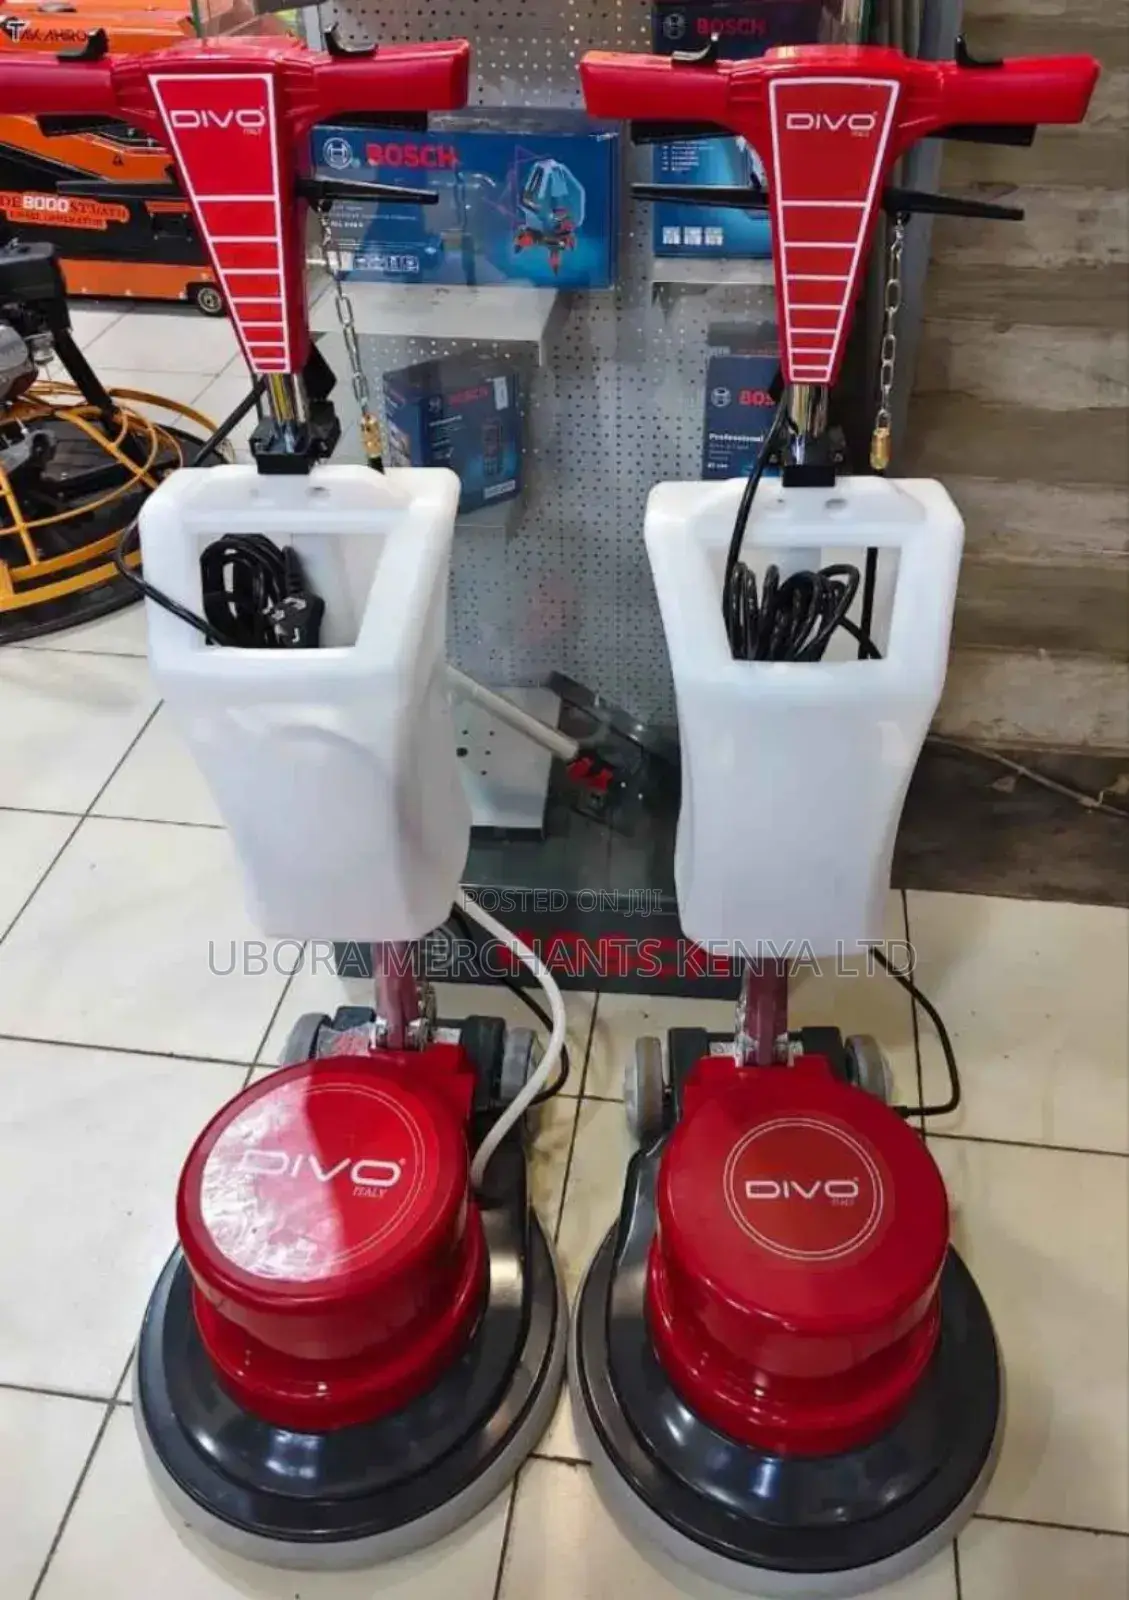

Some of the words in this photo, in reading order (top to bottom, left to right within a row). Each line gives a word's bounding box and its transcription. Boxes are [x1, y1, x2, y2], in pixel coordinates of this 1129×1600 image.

[170, 108, 266, 129] DIVO
[786, 113, 876, 131] DIVO
[366, 143, 458, 168] BOSCH
[236, 1149, 402, 1188] DIVO
[352, 1186, 388, 1199] ITALY
[745, 1180, 859, 1199] DIVO
